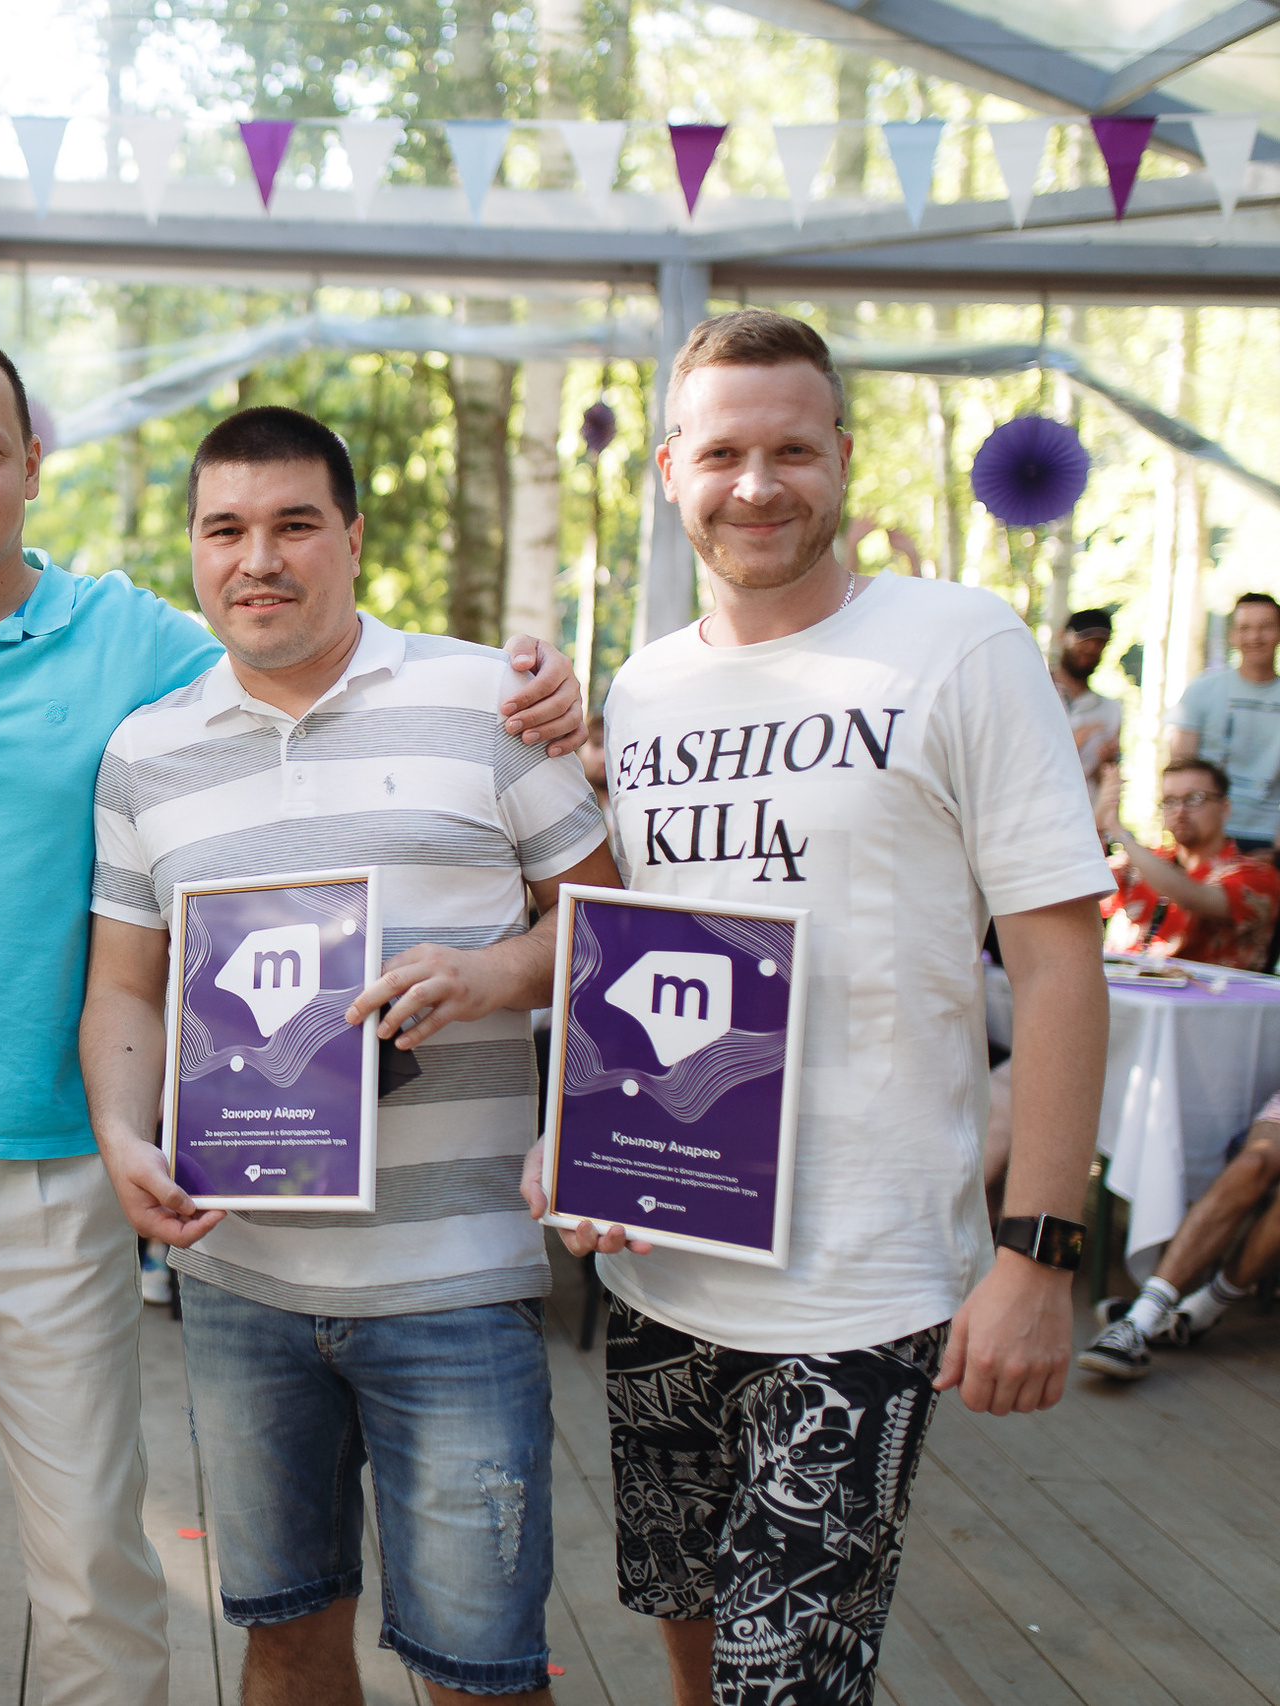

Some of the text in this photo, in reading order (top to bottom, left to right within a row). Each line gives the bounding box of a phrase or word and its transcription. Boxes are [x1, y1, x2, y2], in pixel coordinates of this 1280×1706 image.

[614, 708, 906, 796] FASHION
[644, 798, 809, 882] KILLA
[253, 950, 301, 989] m
[651, 972, 709, 1021] m
[222, 1107, 315, 1121] Закирову Айдару
[612, 1131, 721, 1159] Крылову Андрею
[657, 1202, 686, 1212] maxima
